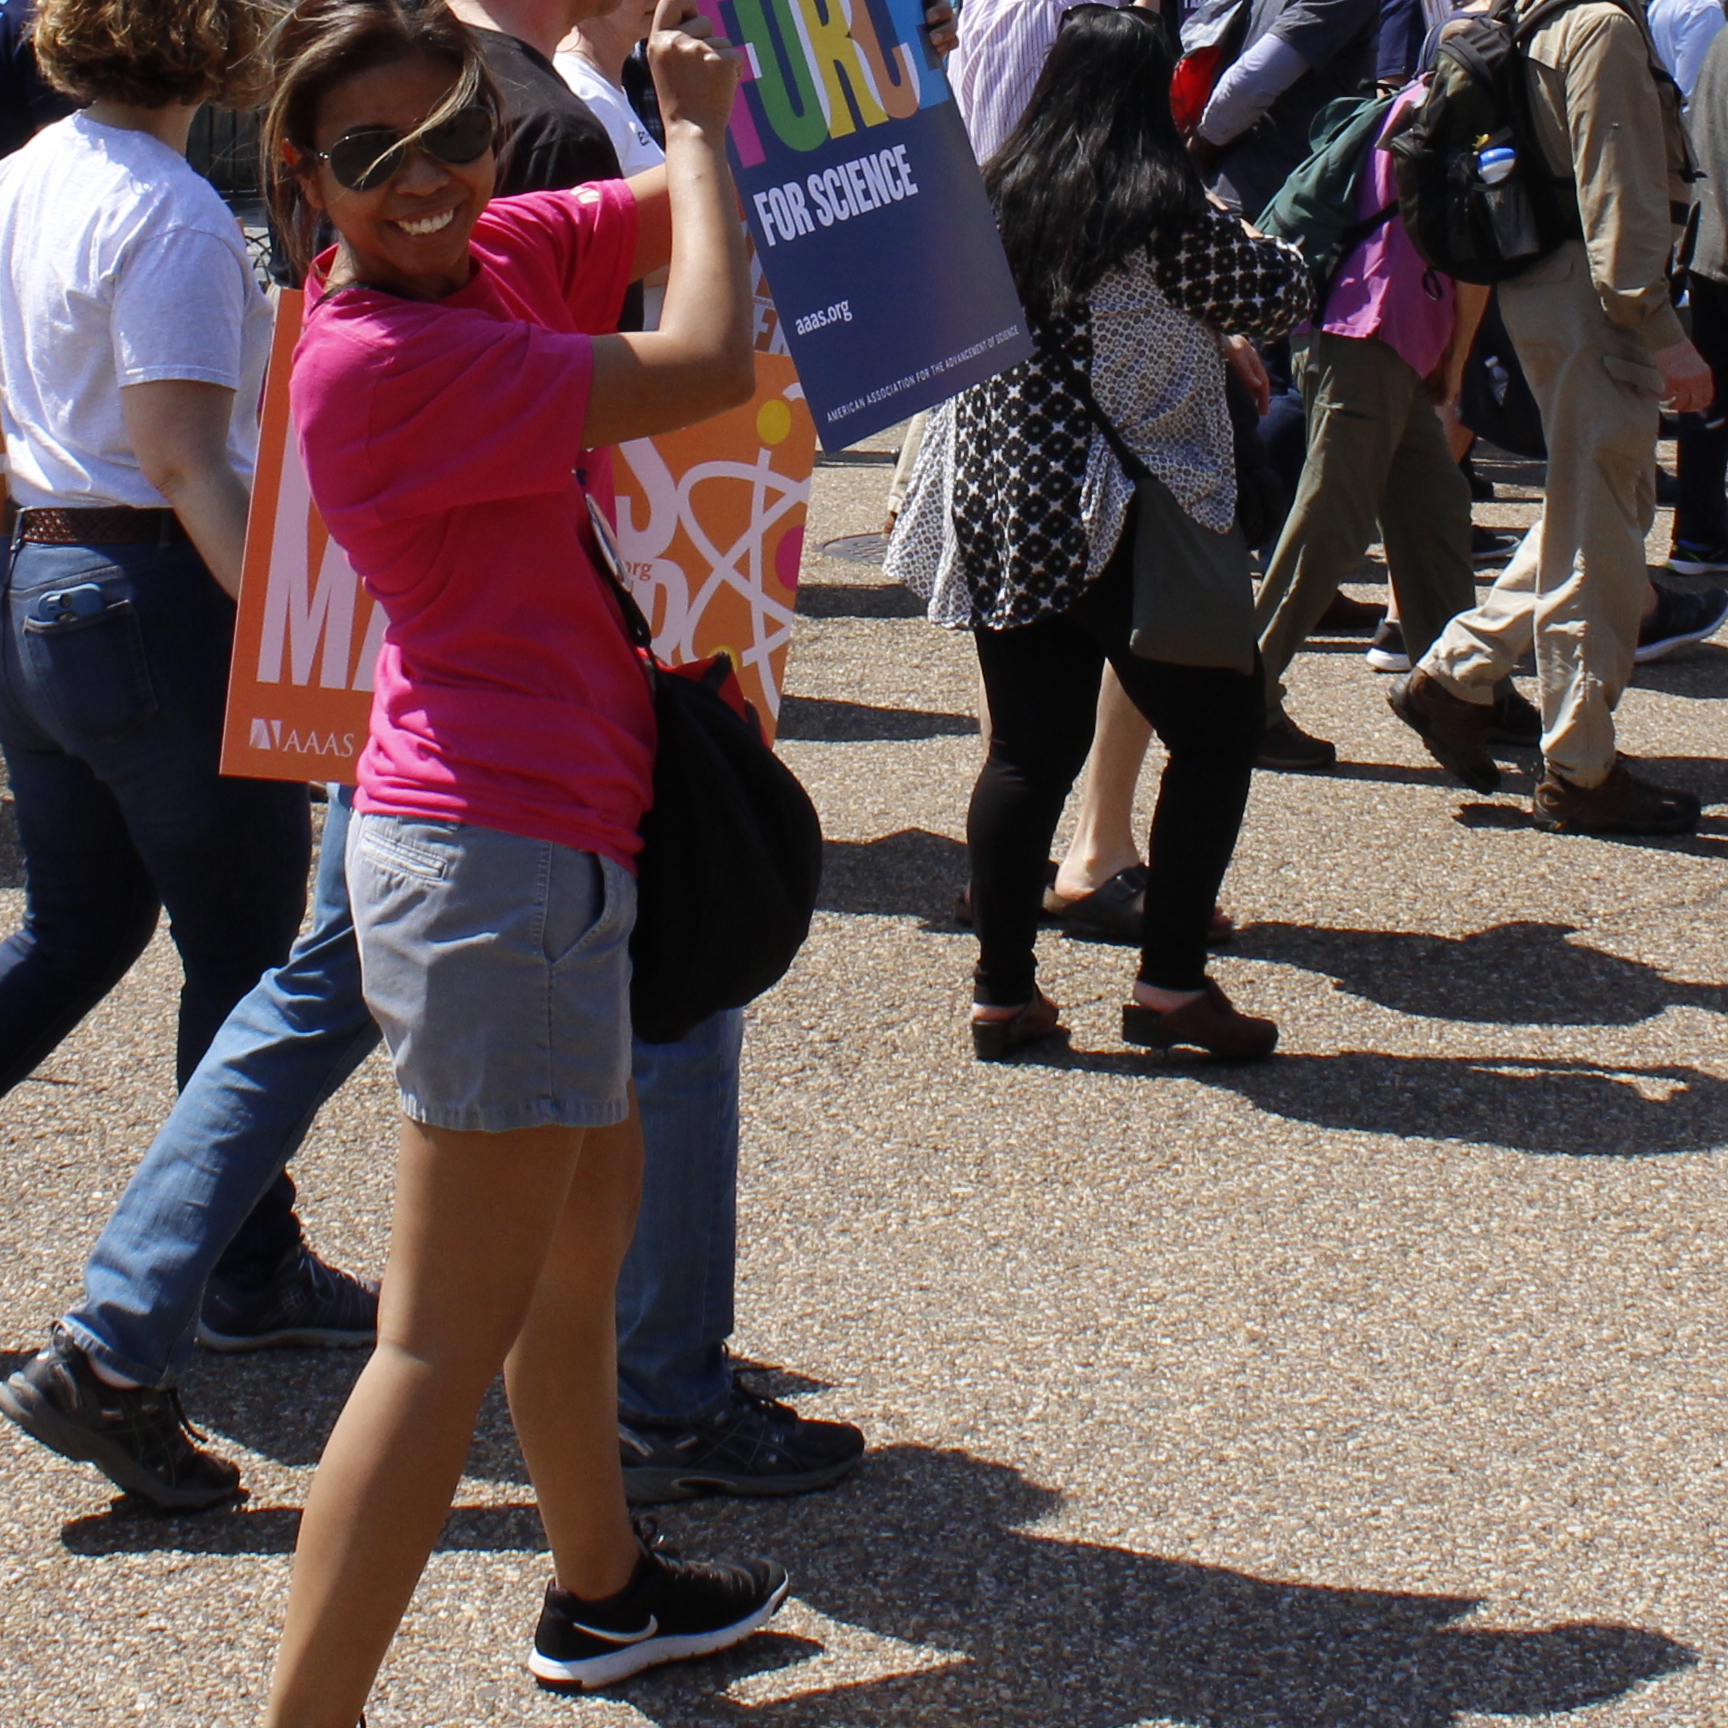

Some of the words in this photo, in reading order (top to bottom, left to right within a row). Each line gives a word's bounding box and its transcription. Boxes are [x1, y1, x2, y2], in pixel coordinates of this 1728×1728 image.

[752, 182, 810, 247] FOR
[807, 143, 919, 229] SCIENCE
[795, 299, 853, 336] aaas.org
[826, 397, 867, 424] AMERICAN
[866, 374, 917, 406] ASSOCIATION
[915, 369, 930, 386] FOR
[930, 362, 945, 378] THE
[945, 341, 988, 369] ADVANCEMENT
[987, 335, 996, 349] OF
[995, 325, 1020, 345] SCIENCE
[282, 729, 355, 758] AAAS
